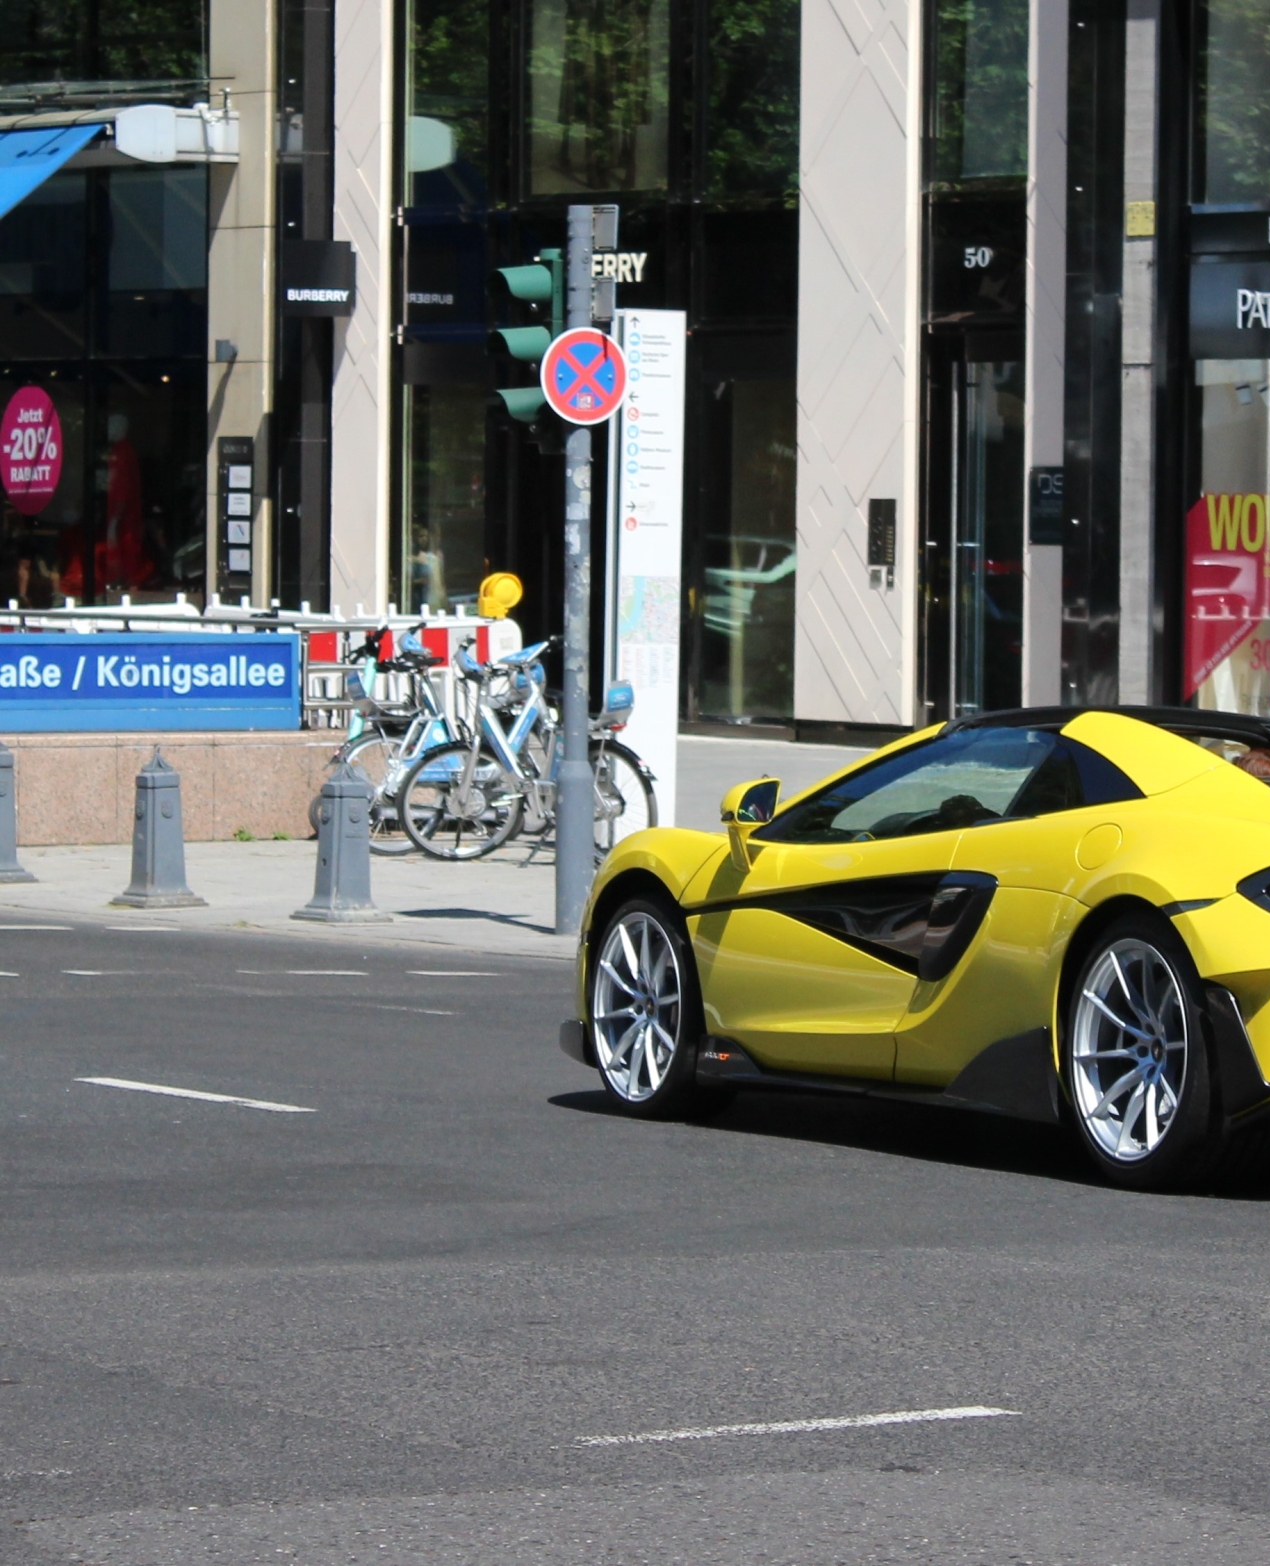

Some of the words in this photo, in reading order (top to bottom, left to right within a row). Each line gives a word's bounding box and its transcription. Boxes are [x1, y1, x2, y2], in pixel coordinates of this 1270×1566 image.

[591, 252, 648, 282] ERRY
[964, 247, 991, 269] 50
[286, 288, 349, 302] BURBERRY
[17, 408, 43, 423] Jetzt
[3, 426, 57, 460] -20%
[10, 466, 51, 482] RABATT
[0, 655, 61, 688] aße
[71, 655, 86, 690] /
[97, 655, 286, 694] Königsallee
